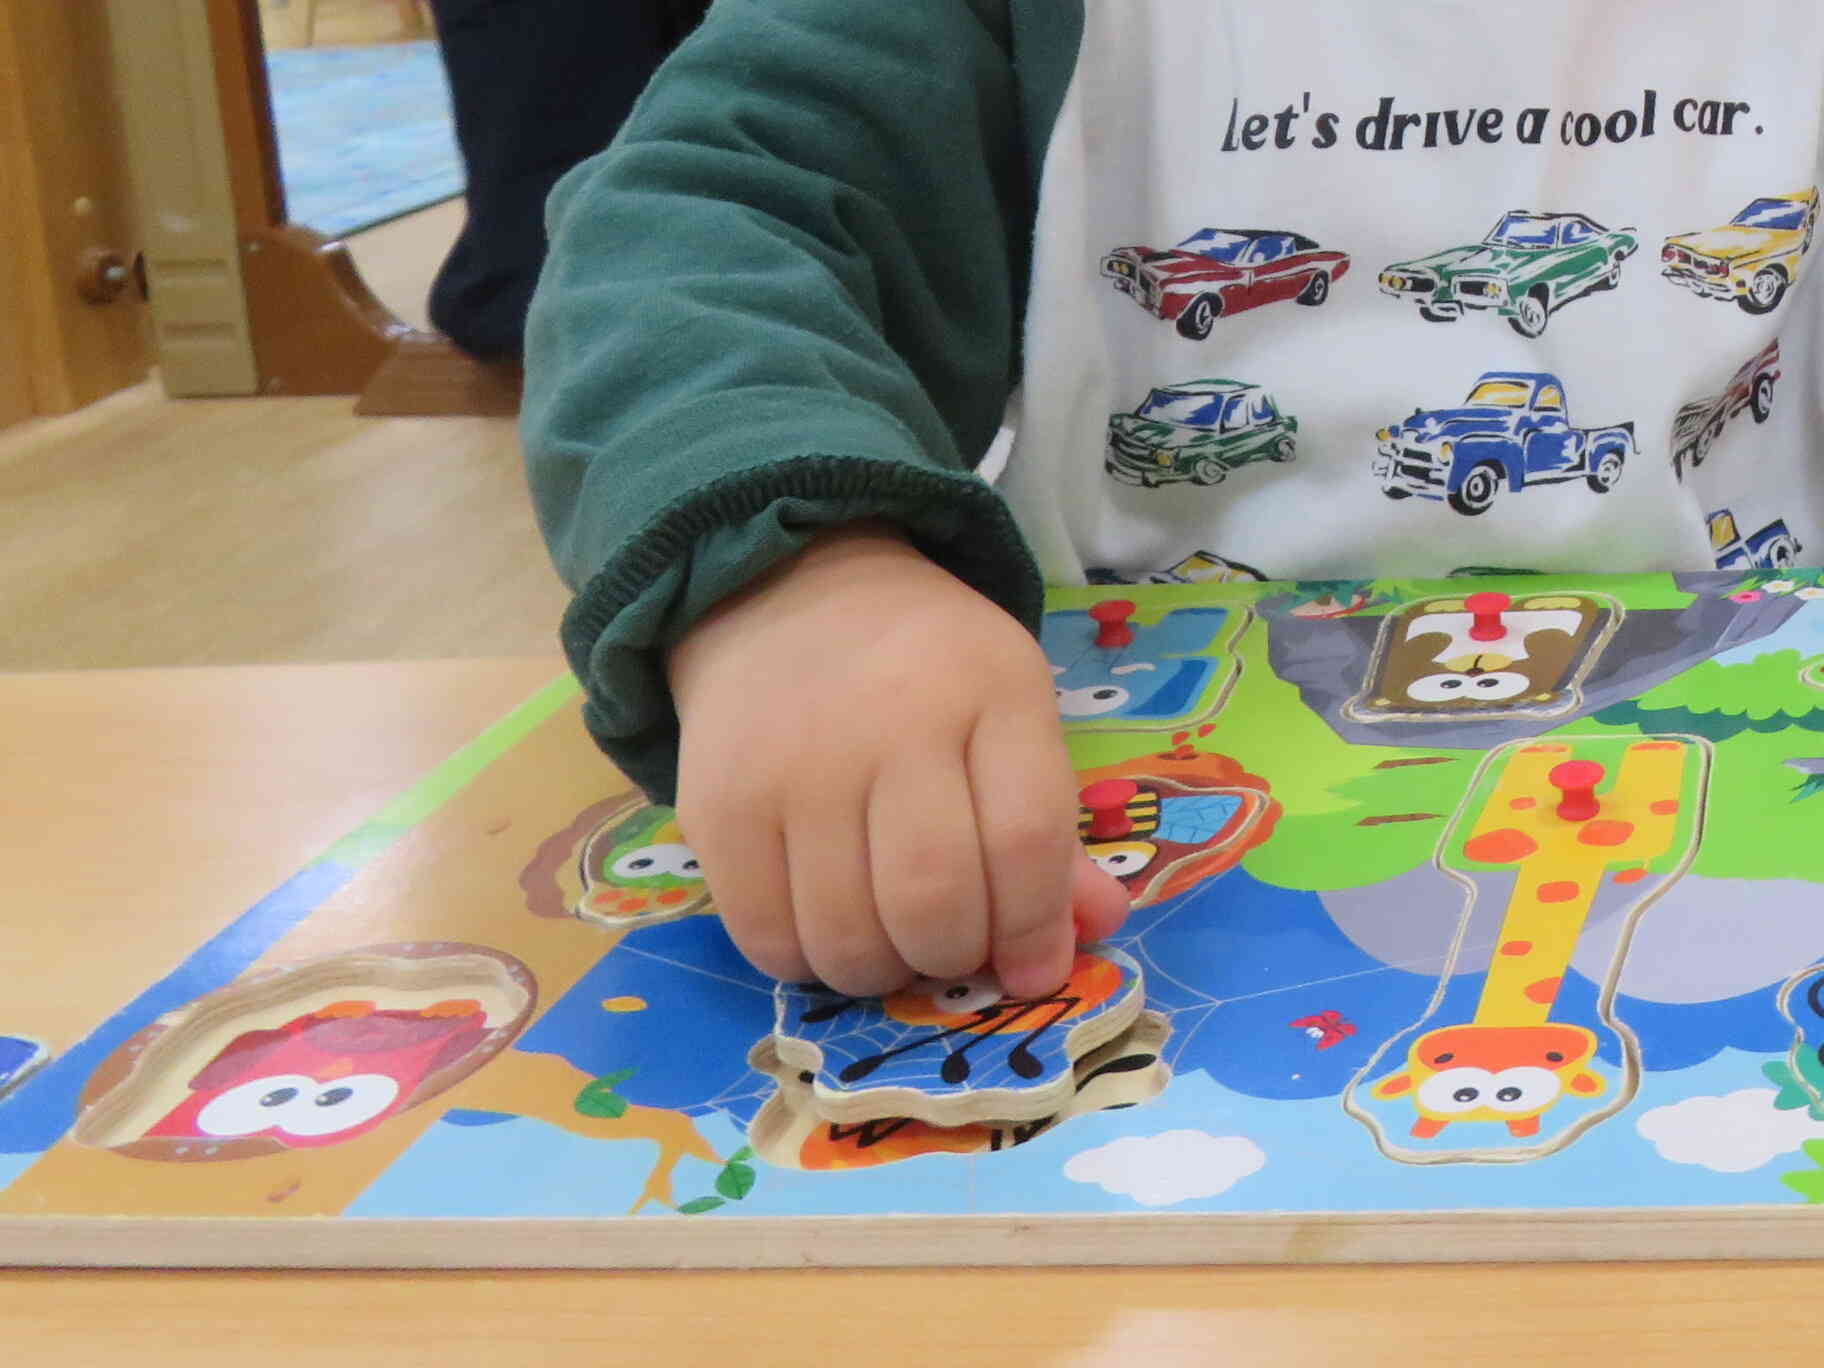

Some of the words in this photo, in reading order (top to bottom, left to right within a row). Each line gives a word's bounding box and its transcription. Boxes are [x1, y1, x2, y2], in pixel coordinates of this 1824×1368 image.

[1221, 92, 1341, 151] let's
[1355, 96, 1505, 151] drive
[1516, 107, 1551, 145] a
[1560, 89, 1657, 147] cool
[1673, 97, 1764, 136] car.
